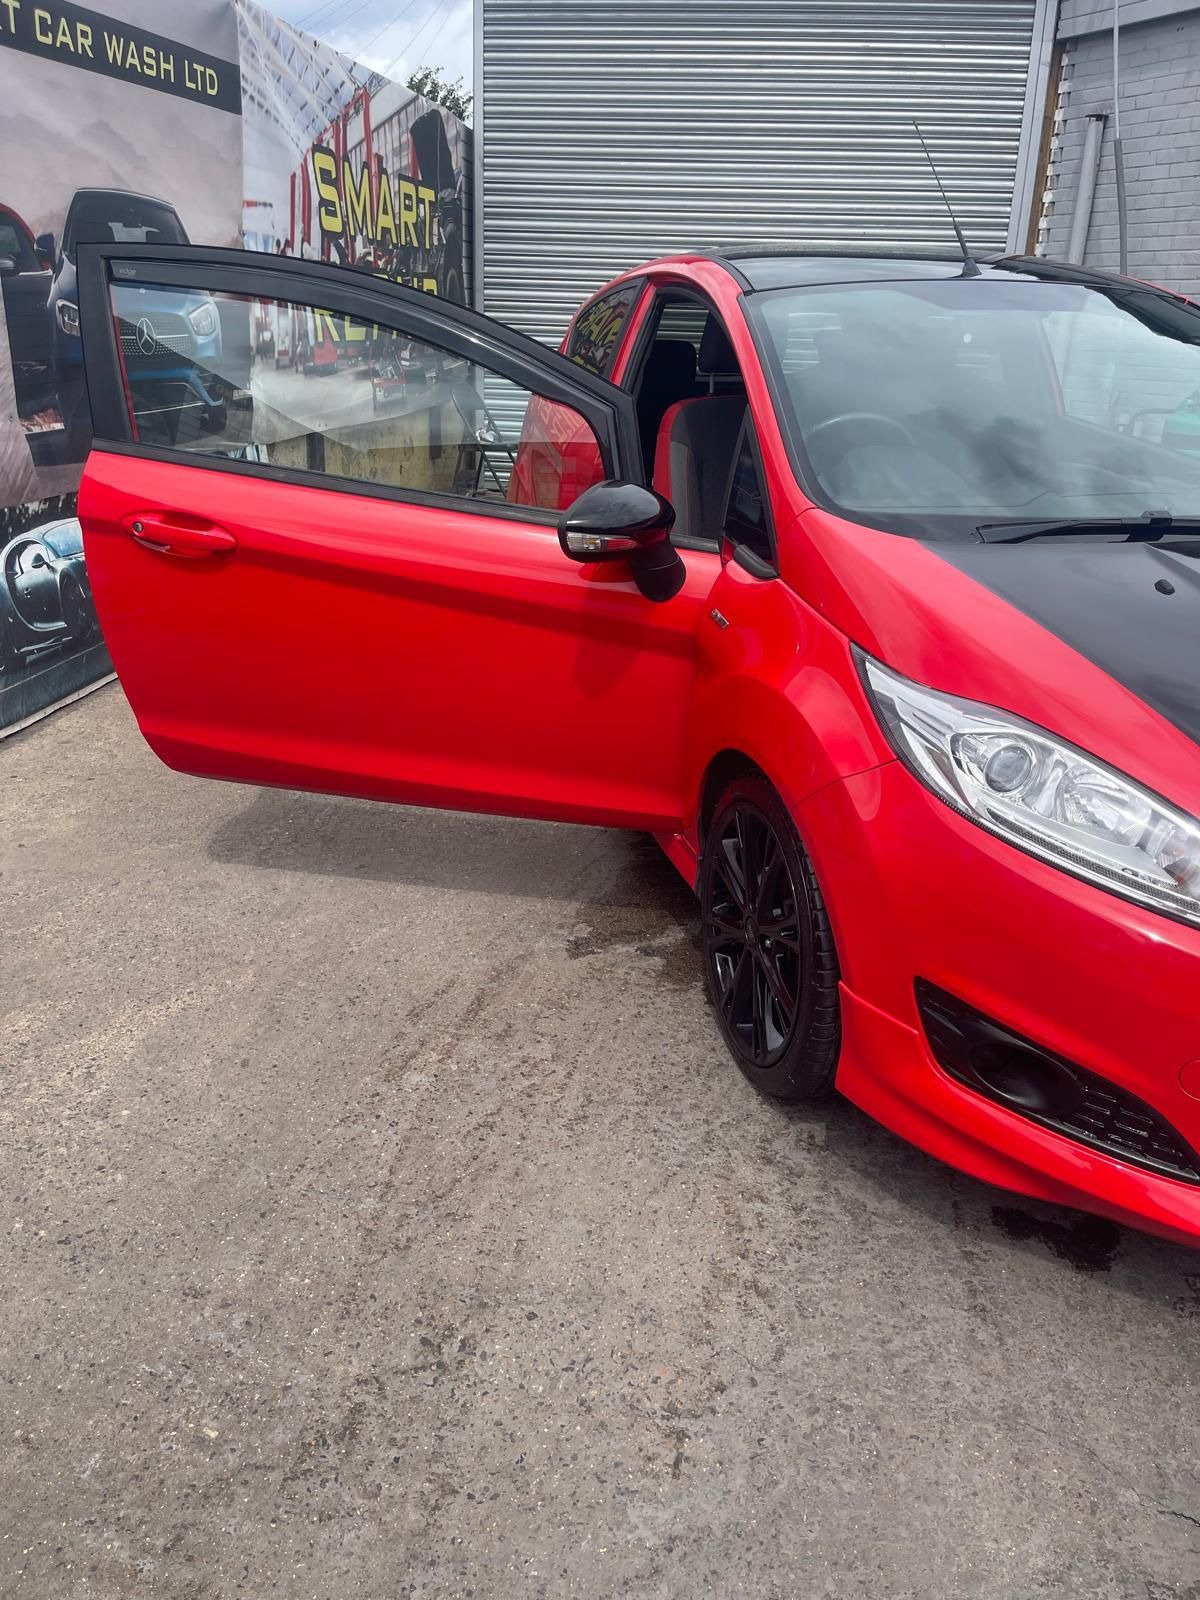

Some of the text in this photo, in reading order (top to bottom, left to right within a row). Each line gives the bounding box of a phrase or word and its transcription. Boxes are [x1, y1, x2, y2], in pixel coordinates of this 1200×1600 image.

[0, 0, 219, 96] T CAR WASH LTD
[313, 151, 438, 249] SMART
